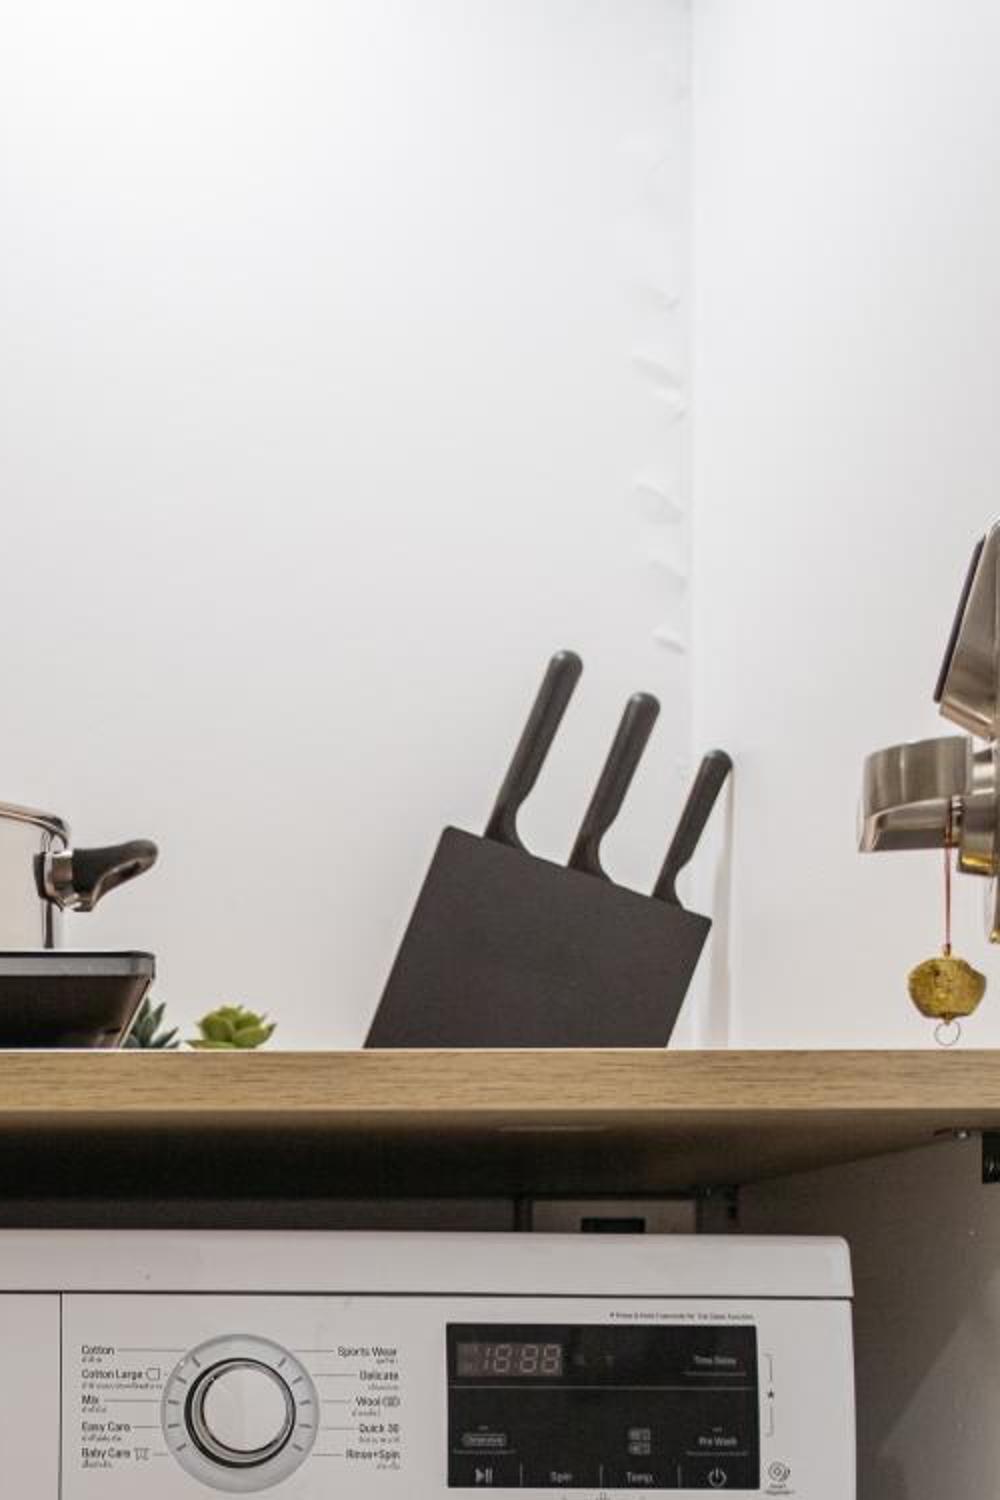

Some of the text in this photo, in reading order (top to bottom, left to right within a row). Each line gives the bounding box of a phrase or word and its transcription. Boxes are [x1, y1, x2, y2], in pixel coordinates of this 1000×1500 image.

[81, 1345, 115, 1355] Cotton
[337, 1346, 397, 1358] Sports Wear
[81, 1369, 143, 1381] Cotton Large
[359, 1370, 399, 1381] Delicate
[355, 1396, 380, 1407] Wool
[107, 1421, 131, 1432] Care
[359, 1423, 385, 1434] Quick
[81, 1447, 131, 1460] Baby Care
